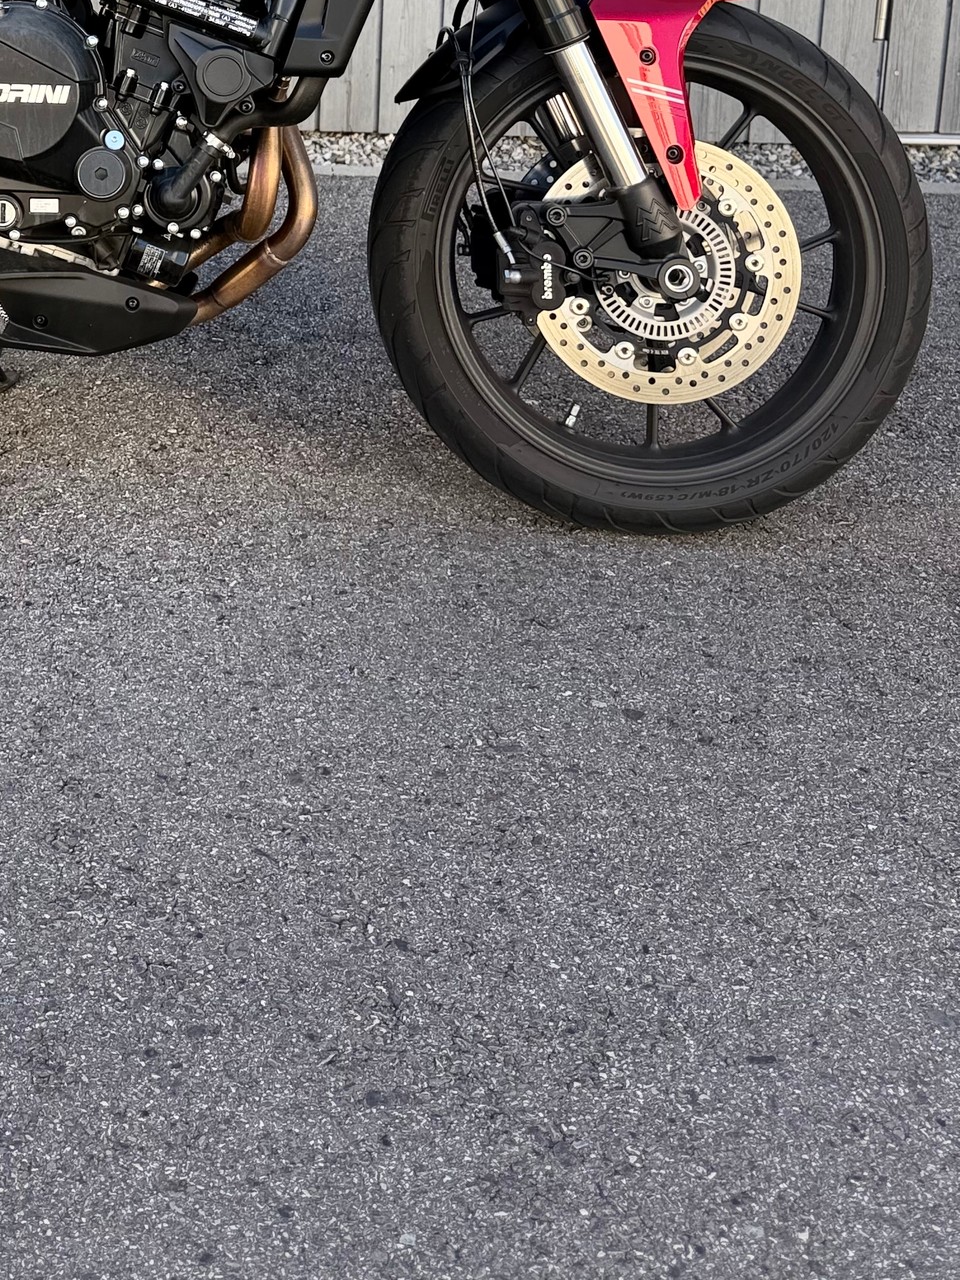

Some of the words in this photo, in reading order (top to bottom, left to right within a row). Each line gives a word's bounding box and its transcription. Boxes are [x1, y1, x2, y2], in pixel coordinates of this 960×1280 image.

[540, 253, 553, 300] brembo
[780, 422, 840, 473] 120/70
[746, 468, 775, 489] ZR
[675, 489, 712, 502] M/C
[717, 483, 737, 497] 18
